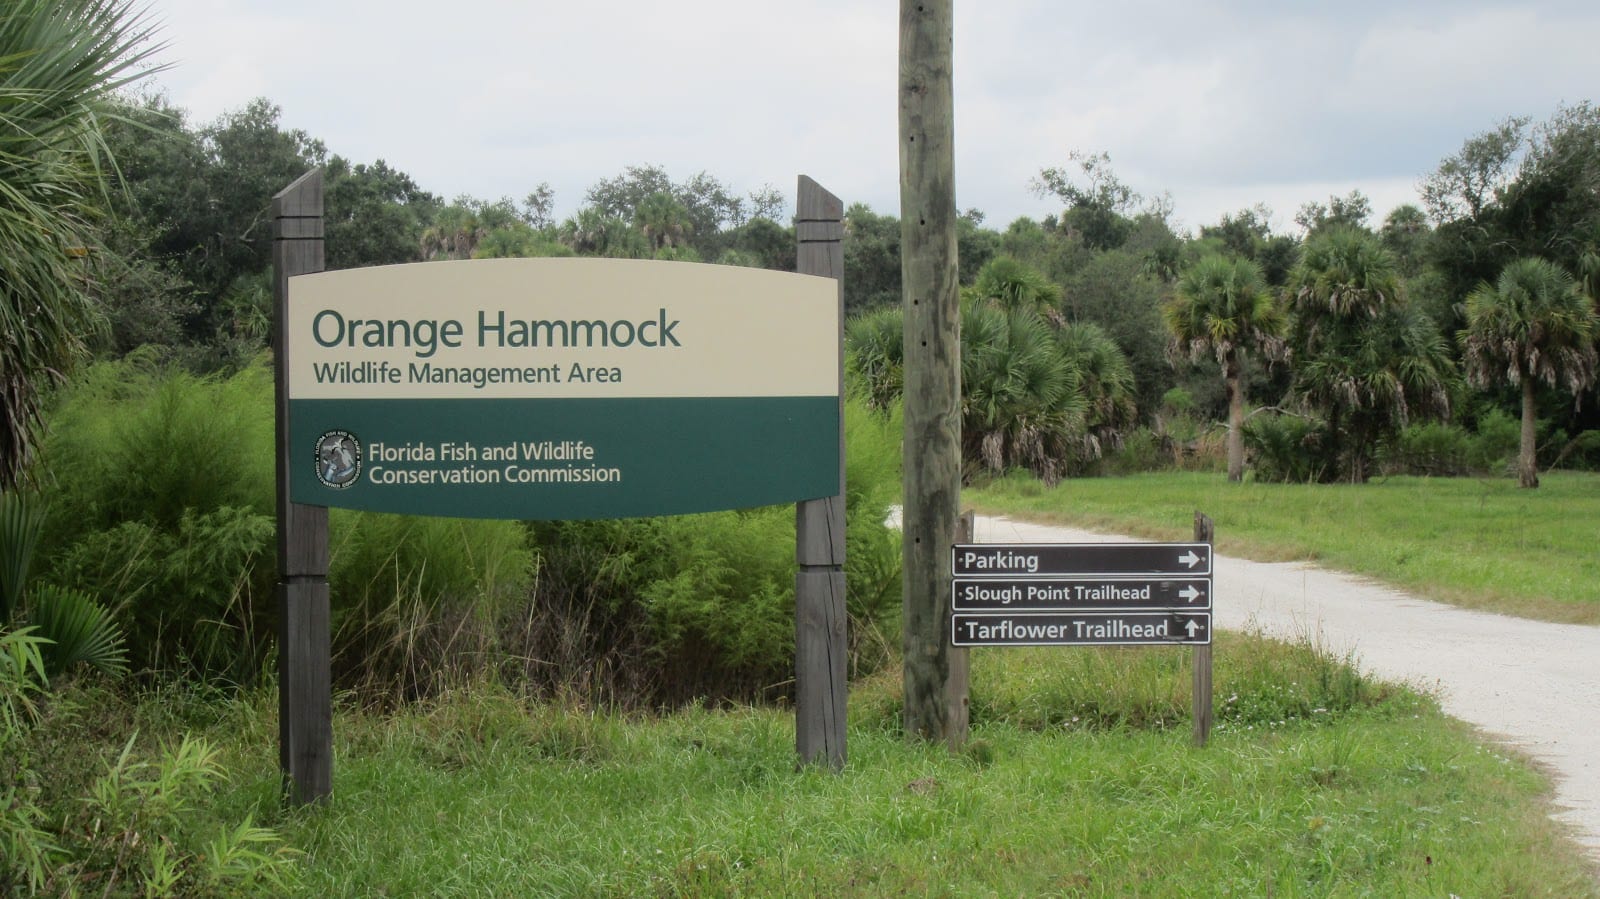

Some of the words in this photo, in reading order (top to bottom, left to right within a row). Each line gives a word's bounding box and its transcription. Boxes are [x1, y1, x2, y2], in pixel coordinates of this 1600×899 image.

[312, 309, 464, 358] Orange
[477, 308, 682, 348] Hammock
[313, 361, 402, 384] Wildlife
[408, 362, 561, 389] Management
[567, 362, 622, 383] Area
[369, 442, 435, 462] Florida
[440, 442, 477, 461] Fish
[482, 442, 518, 461] and
[522, 441, 595, 460] Wildlife
[369, 465, 500, 484] Conservation
[504, 464, 621, 483] Commission
[964, 551, 1039, 573] Parking
[965, 585, 1022, 604] Slough
[1027, 586, 1071, 601] Point
[1074, 584, 1151, 600] Trailhead
[966, 619, 1068, 640] Tarflower
[1072, 619, 1169, 639] Trailhead
